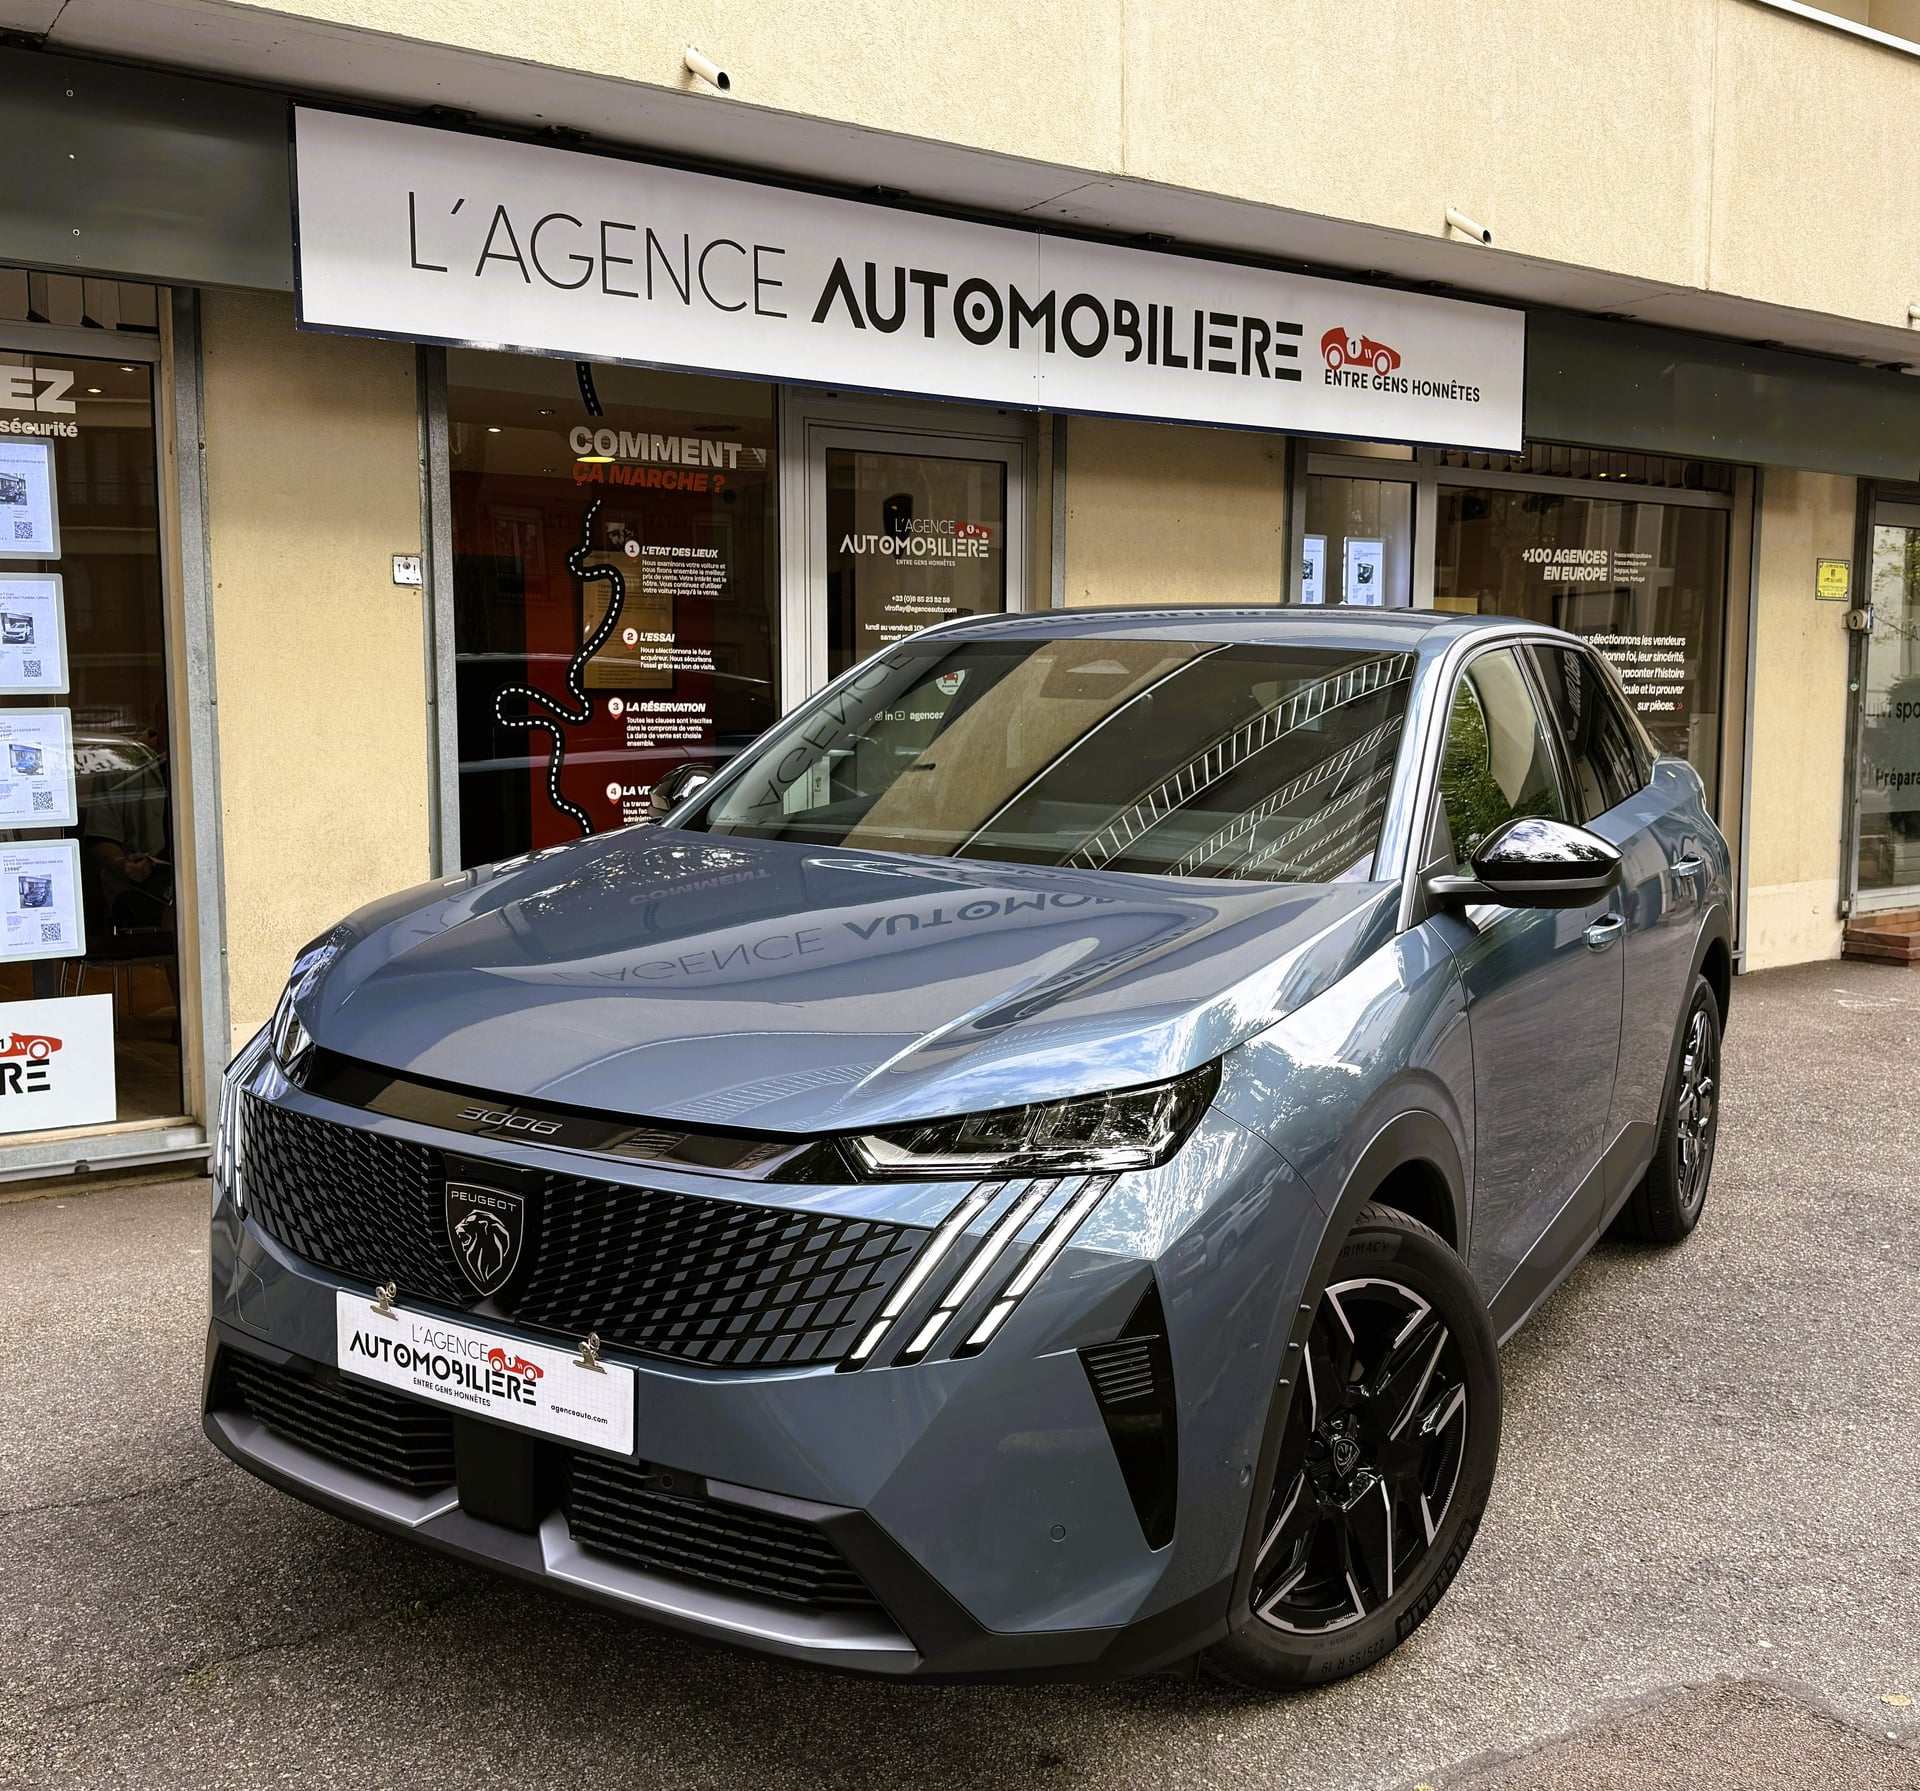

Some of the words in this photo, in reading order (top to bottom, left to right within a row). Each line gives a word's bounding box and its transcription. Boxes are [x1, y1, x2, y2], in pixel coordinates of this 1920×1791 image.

[408, 191, 788, 319] L'AGENCE
[811, 257, 1304, 382] AUTOMOBILIERE
[1325, 369, 1368, 389] ENTRE
[1372, 375, 1408, 394] GENS
[1412, 379, 1480, 402] HONNÊTES
[0, 417, 78, 437] sécurité
[569, 426, 742, 469] COMMENT
[572, 463, 605, 486] ÇA
[609, 465, 709, 492] MARCHE
[895, 518, 955, 535] L'AGENCE
[641, 545, 671, 555] L'ETAT
[672, 547, 691, 557] DES
[692, 548, 718, 559] LIEUX
[839, 533, 989, 558] AUTOMOBILIERE
[1522, 548, 1552, 563] +100
[1552, 549, 1608, 565] AGENCES
[1543, 566, 1560, 581] EN
[1561, 566, 1608, 582] EUROPE
[865, 623, 879, 631] lundi
[640, 632, 675, 643] L'ESSAI
[1589, 633, 1641, 646] sélectionnons
[1641, 634, 1652, 646] les
[1653, 635, 1686, 646] vendeurs
[1602, 650, 1625, 662] bonne
[1638, 651, 1652, 662] leur
[1621, 668, 1654, 678] raconter
[1622, 684, 1639, 695] icule
[1640, 685, 1648, 695] et
[1649, 684, 1656, 695] la
[1656, 685, 1685, 696] prouver
[626, 702, 639, 712] LA
[640, 700, 706, 713] RÉSERVATION
[1637, 701, 1649, 711] sur
[1649, 699, 1675, 713] pièces.
[622, 786, 636, 796] LA
[456, 1106, 563, 1135] 3008
[451, 1190, 517, 1212] PEUGEOT
[411, 1323, 489, 1363] L'AGENCE
[349, 1330, 537, 1407] AUTOMOBILIERE
[413, 1377, 433, 1390] ENTRE
[434, 1383, 453, 1396] GENS
[454, 1388, 491, 1407] HONNÊTES
[550, 1404, 608, 1425] agenceauto.com
